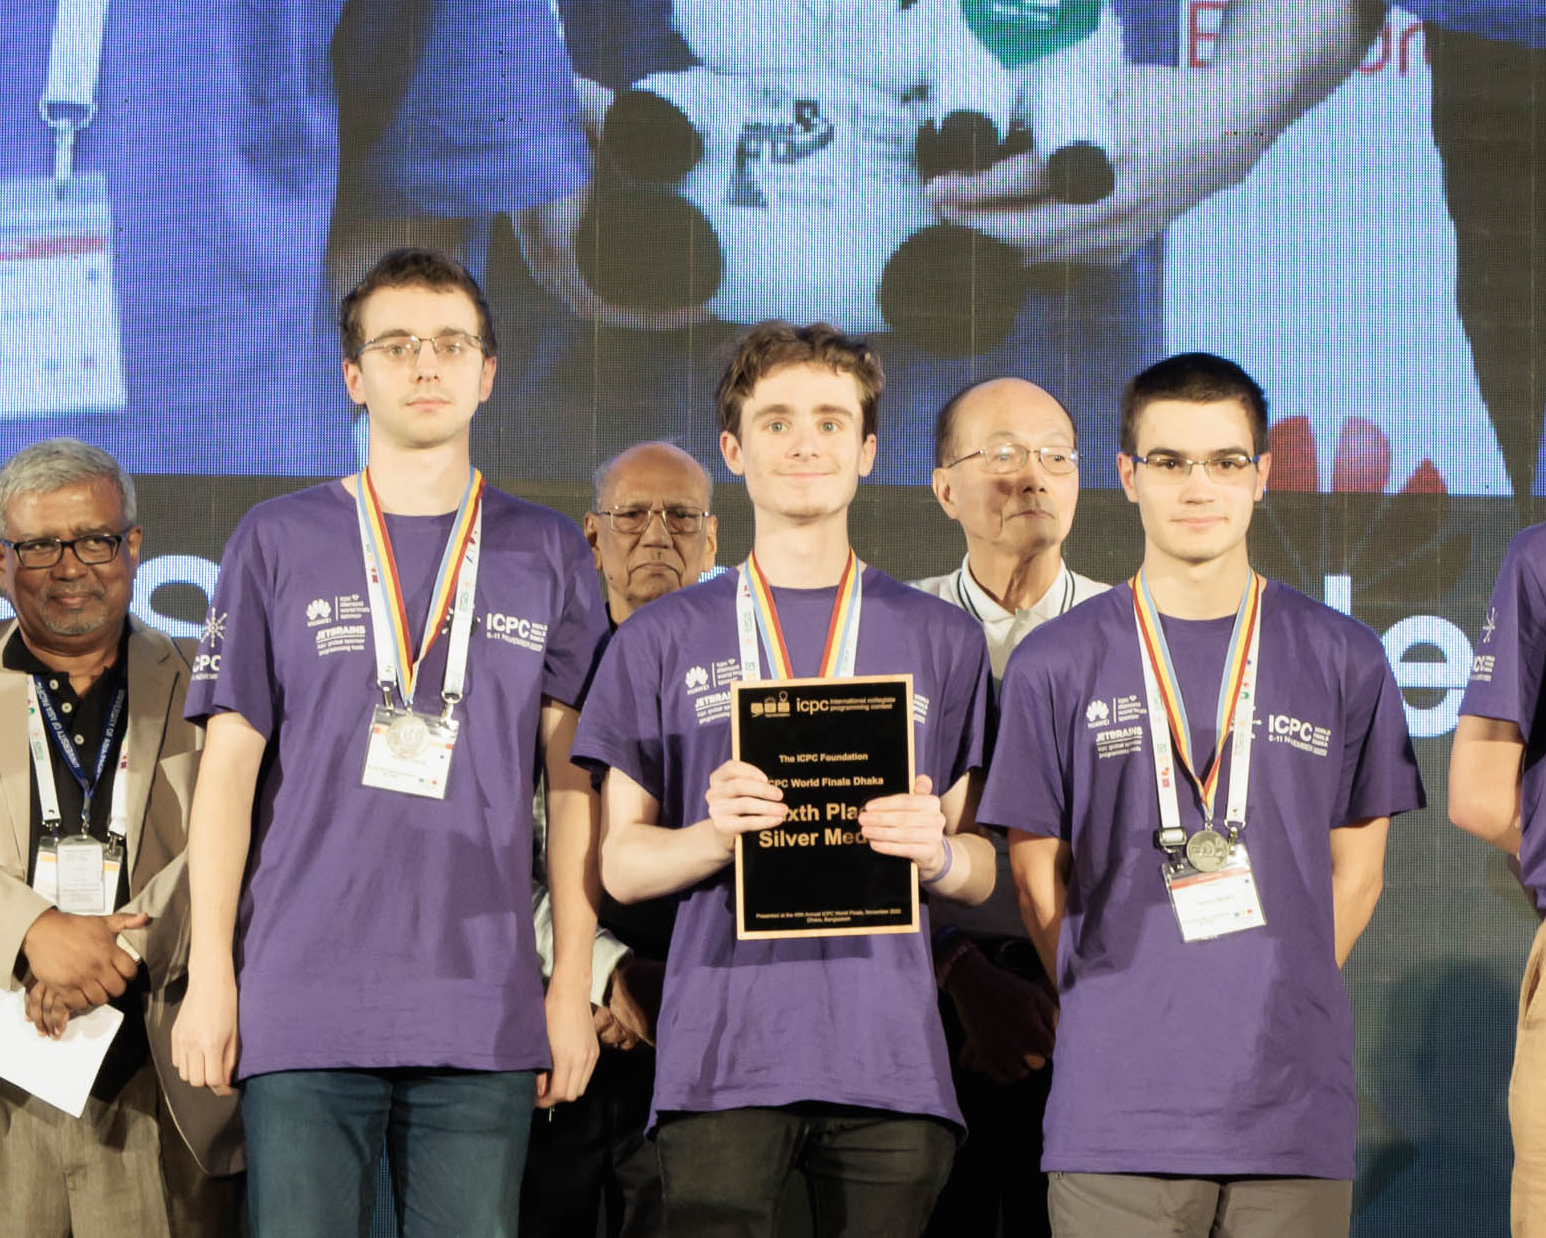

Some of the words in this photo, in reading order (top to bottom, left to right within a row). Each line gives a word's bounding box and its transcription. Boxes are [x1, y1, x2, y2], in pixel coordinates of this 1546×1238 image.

[316, 625, 366, 641] JETBRAINS
[486, 612, 531, 638] ICPC
[796, 697, 829, 715] icpc
[1096, 726, 1142, 742] JETBRAINS
[1268, 714, 1312, 742] ICPC
[779, 754, 796, 763] The
[797, 754, 818, 762] ICPC
[820, 752, 868, 762] Foundation
[791, 778, 820, 788] World
[822, 777, 851, 787] Finals
[853, 776, 884, 786] Dhaka
[759, 830, 819, 848] Silver
[824, 828, 871, 846] Med
